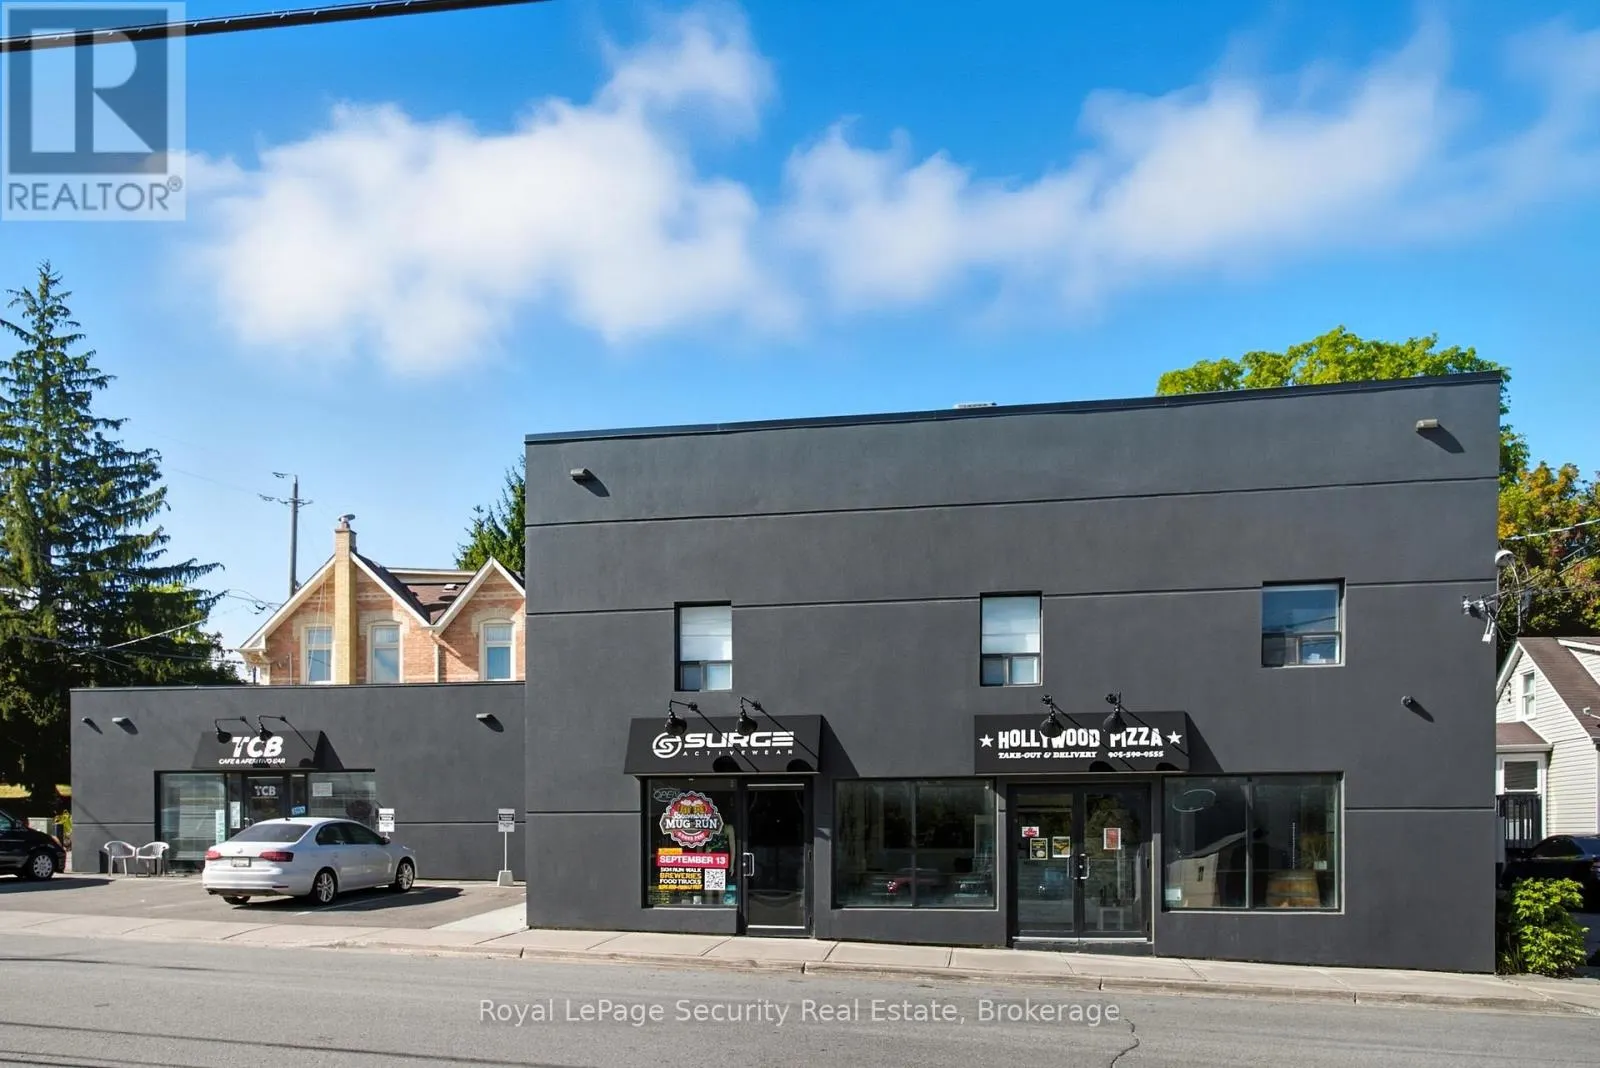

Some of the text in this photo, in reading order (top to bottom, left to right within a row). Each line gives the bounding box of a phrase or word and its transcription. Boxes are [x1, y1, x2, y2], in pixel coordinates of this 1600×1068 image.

[684, 731, 794, 748] SURGE
[998, 727, 1163, 749] HOLLYWOOD PIZZA
[232, 736, 284, 758] TCB
[682, 749, 793, 757] ACTIVEWEAR
[1053, 751, 1097, 759] DELIVERY
[254, 785, 276, 796] TCB
[665, 818, 718, 829] MUG RUN
[659, 855, 726, 864] SEPTEMBER 13
